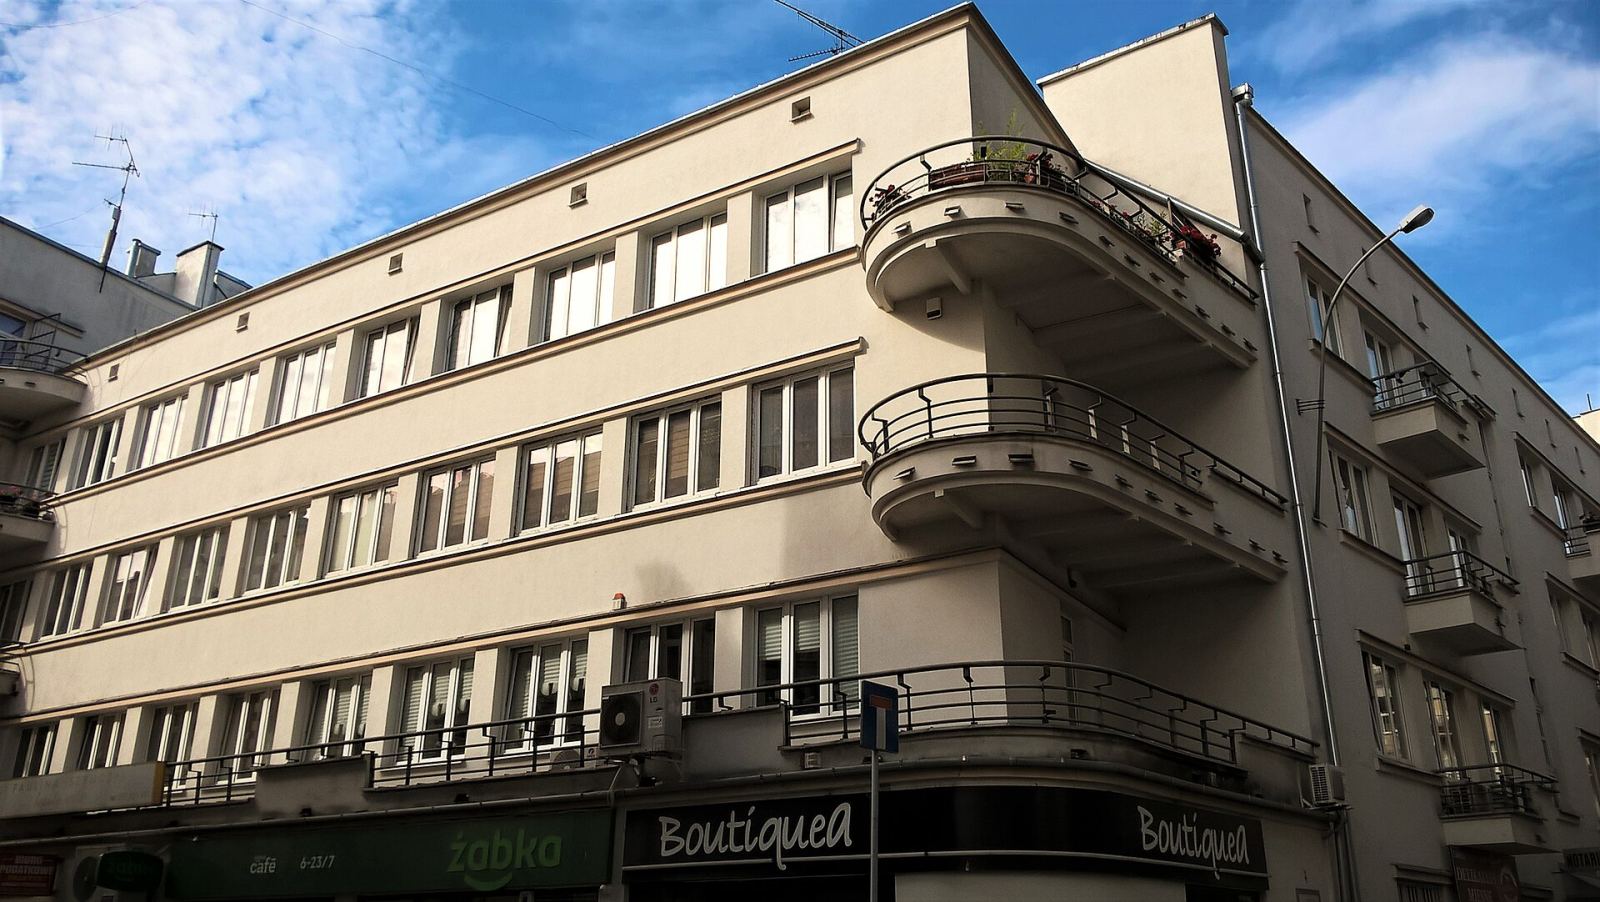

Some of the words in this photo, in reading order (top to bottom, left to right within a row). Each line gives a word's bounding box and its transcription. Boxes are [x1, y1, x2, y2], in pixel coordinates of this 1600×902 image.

[446, 828, 563, 872] żabka
[658, 802, 853, 871] Boutiquea
[1136, 805, 1250, 881] Boutiquea
